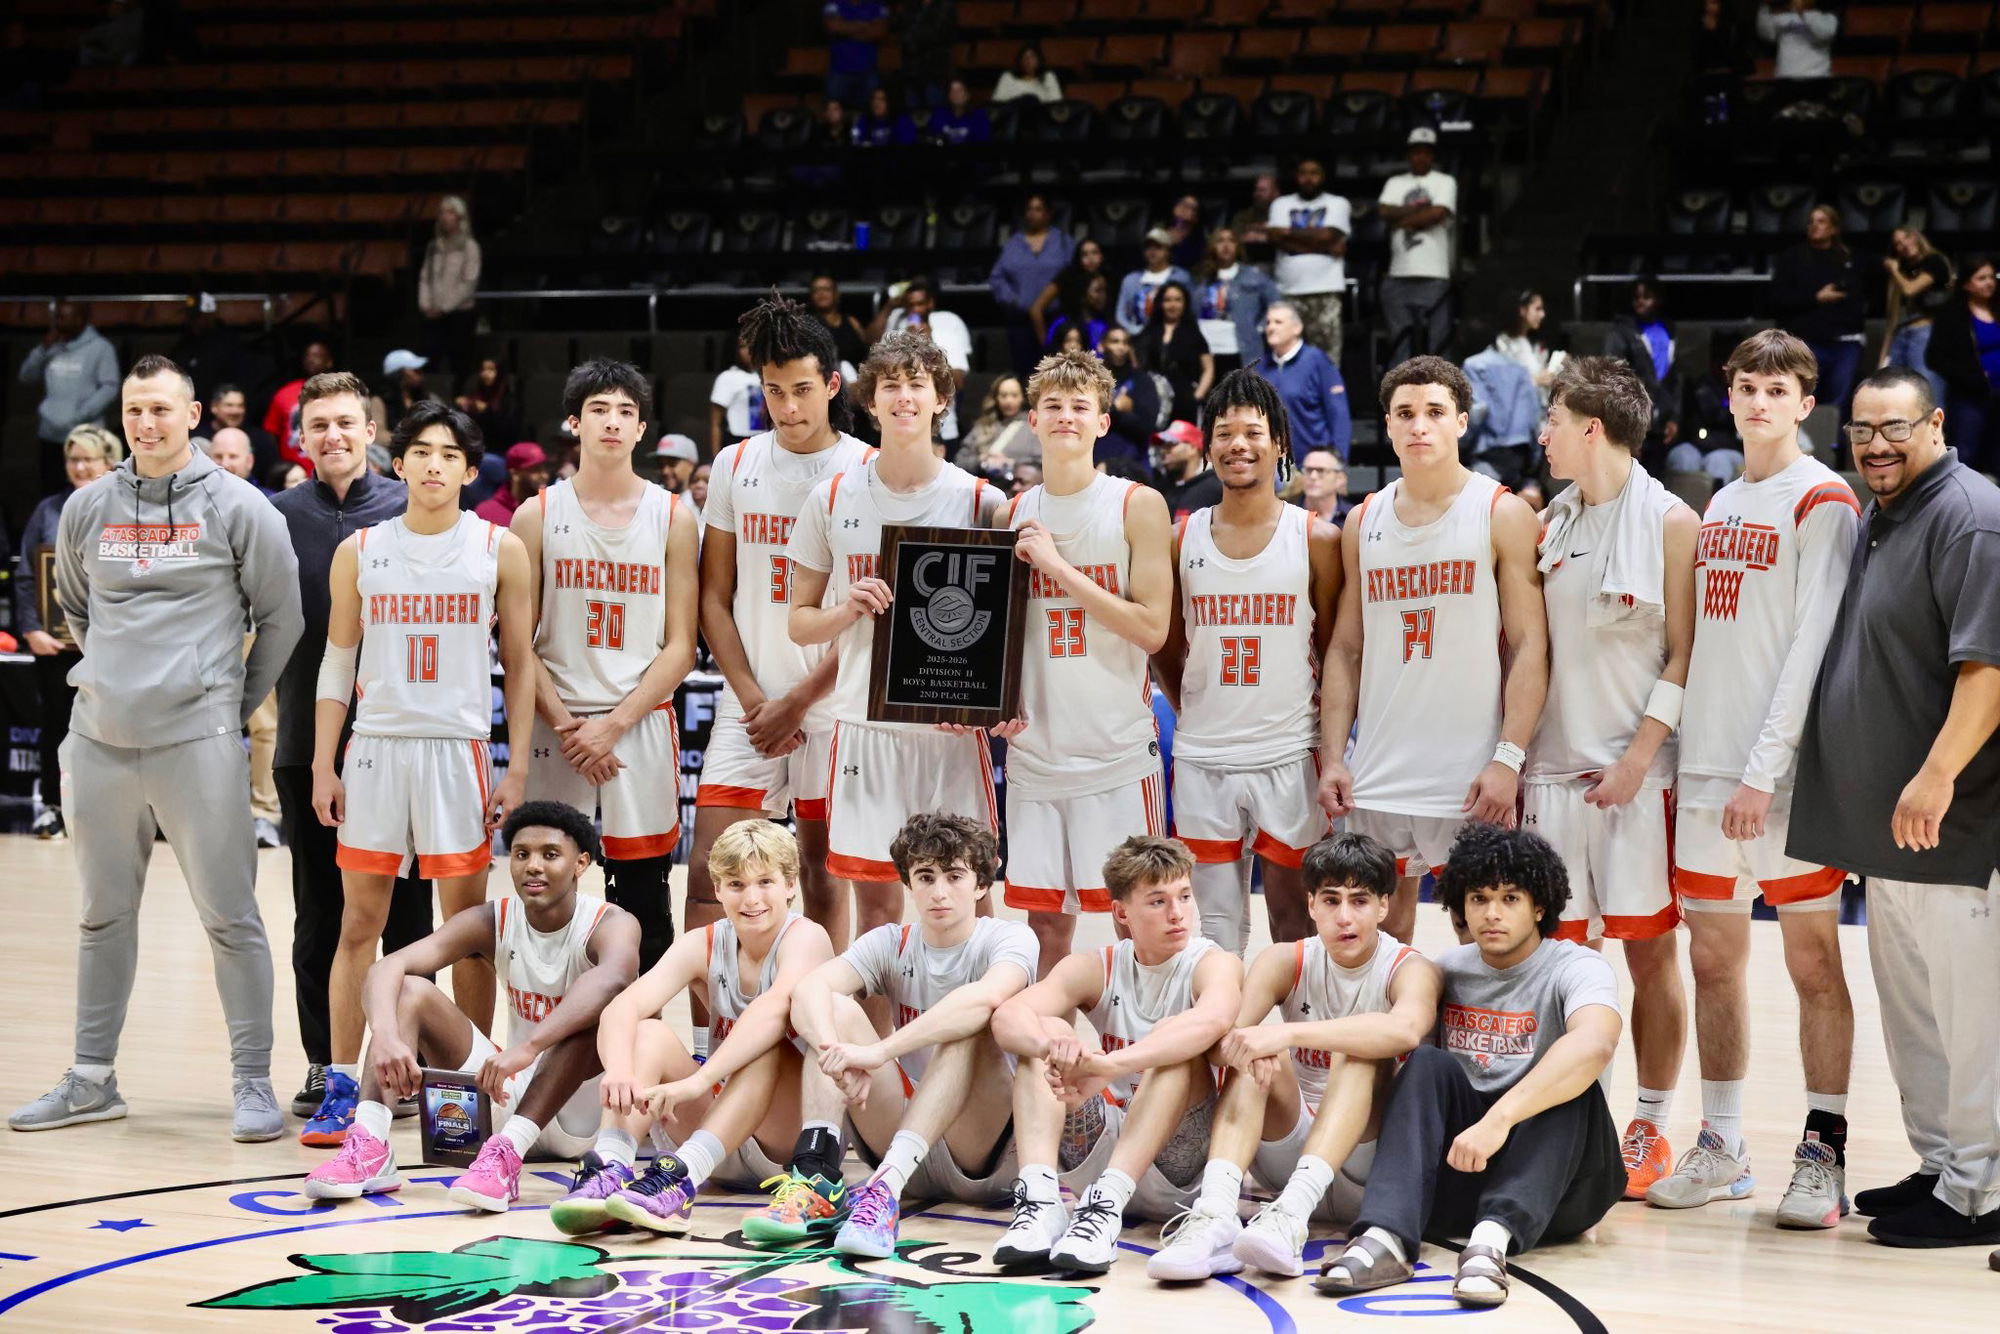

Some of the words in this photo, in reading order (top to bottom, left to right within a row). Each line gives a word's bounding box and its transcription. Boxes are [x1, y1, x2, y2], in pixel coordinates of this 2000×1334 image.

[98, 541, 199, 557] BASKETBALL
[101, 527, 200, 542] ATASCADERO
[1695, 526, 1780, 566] TASCADERO
[556, 558, 661, 596] ATASCADERO
[769, 554, 798, 605] 3
[912, 551, 996, 598] CIF
[1367, 559, 1477, 603] ATASCADERO
[369, 593, 480, 625] ATASCADERO
[585, 599, 626, 651] 30
[913, 610, 947, 648] CENTRAL
[950, 613, 988, 648] SECTION
[1046, 607, 1087, 658] 23
[1400, 606, 1436, 664] 24
[405, 634, 440, 683] 10
[919, 667, 961, 678] DIVISION
[966, 669, 973, 678] II
[926, 654, 968, 665] 2025-2026
[1219, 636, 1262, 686] 22
[903, 678, 926, 686] BOYS
[930, 679, 988, 690] BASKETBALL
[920, 690, 938, 699] 2ND
[940, 691, 969, 701] PLACE
[1446, 1027, 1536, 1054] ASKETBALL
[437, 1120, 470, 1131] FINALS
